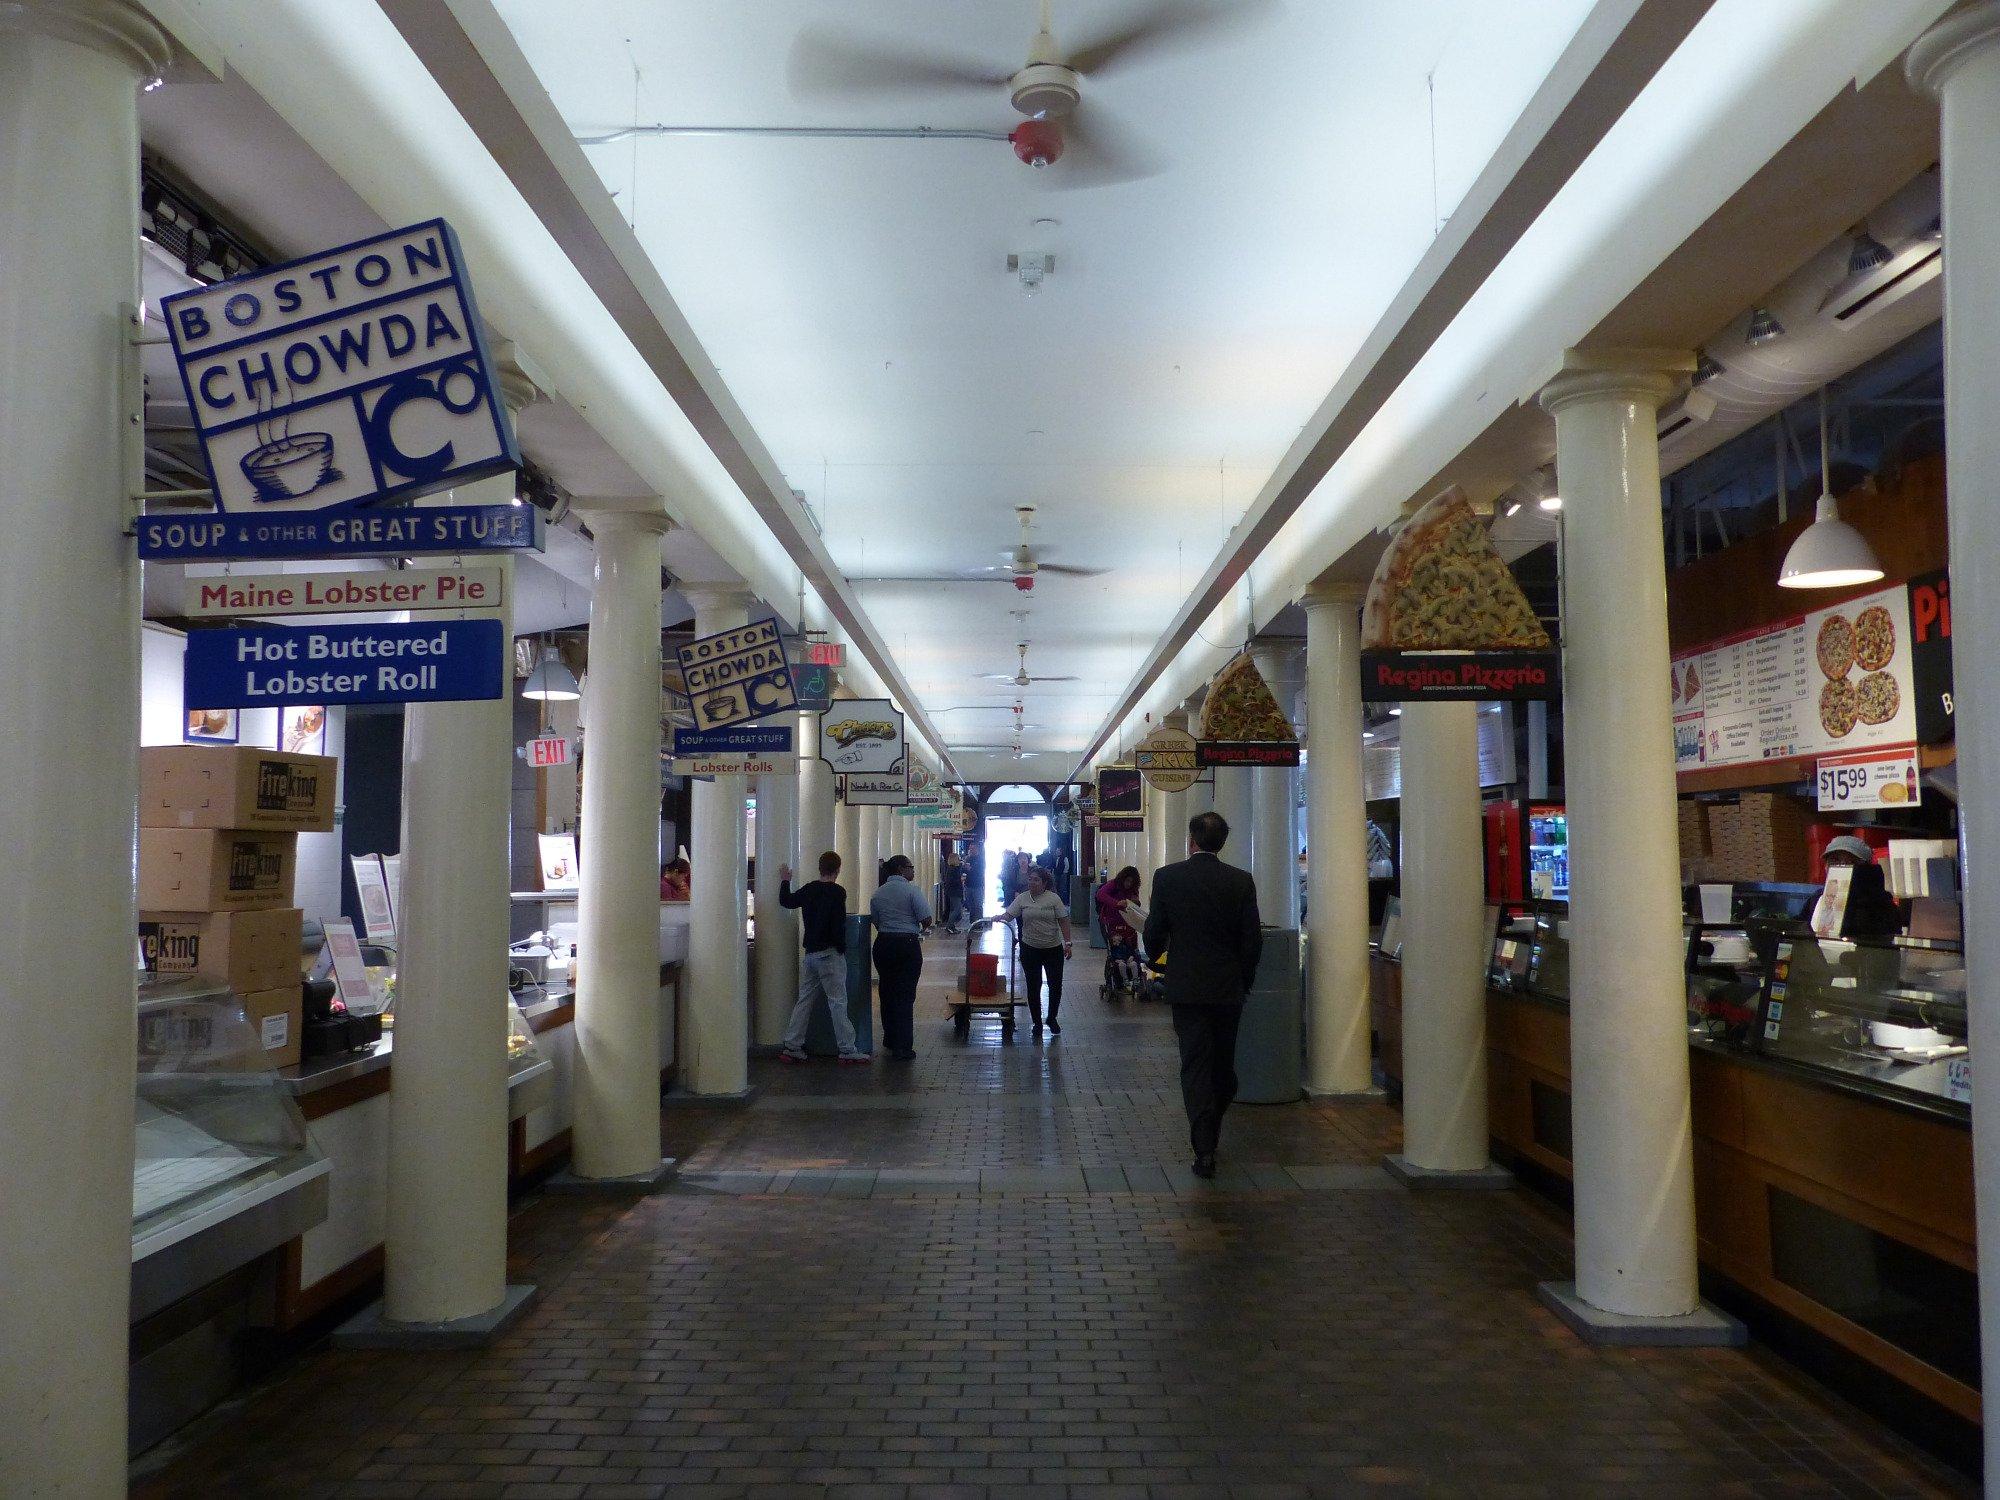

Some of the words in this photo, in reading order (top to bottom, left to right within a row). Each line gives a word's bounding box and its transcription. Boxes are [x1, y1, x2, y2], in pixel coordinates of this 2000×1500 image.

[179, 237, 442, 342] BOSTON
[199, 302, 461, 409] CHOWDA
[148, 522, 226, 549] SOUP
[239, 528, 249, 541] &
[256, 525, 318, 542] OTHER
[328, 517, 422, 544] GREAT
[433, 515, 524, 541] STUFF
[200, 584, 294, 609] Maine
[305, 578, 426, 606] Lobster
[436, 574, 486, 601] Pie
[237, 636, 298, 662] Hot
[308, 630, 449, 660] Buttered
[681, 625, 776, 662] BOSTON
[814, 644, 842, 665] EXIT
[245, 668, 367, 697] Lobster
[377, 666, 438, 692] Roll
[687, 651, 783, 687] CHOWDA
[1378, 662, 1455, 691] Regina
[1461, 663, 1546, 692] Pizzeria
[534, 739, 566, 766] EXIT
[680, 736, 703, 745] SOUP
[728, 735, 756, 744] GREAT
[758, 734, 784, 743] STUFF
[1151, 740, 1189, 750] GREEK
[1204, 748, 1244, 762] Regina
[1247, 747, 1293, 762] Pizzeria
[693, 762, 740, 773] Lobster
[743, 761, 773, 773] Rolls
[1151, 773, 1191, 783] CUISINE
[1101, 821, 1142, 829] SMOOTHIES
